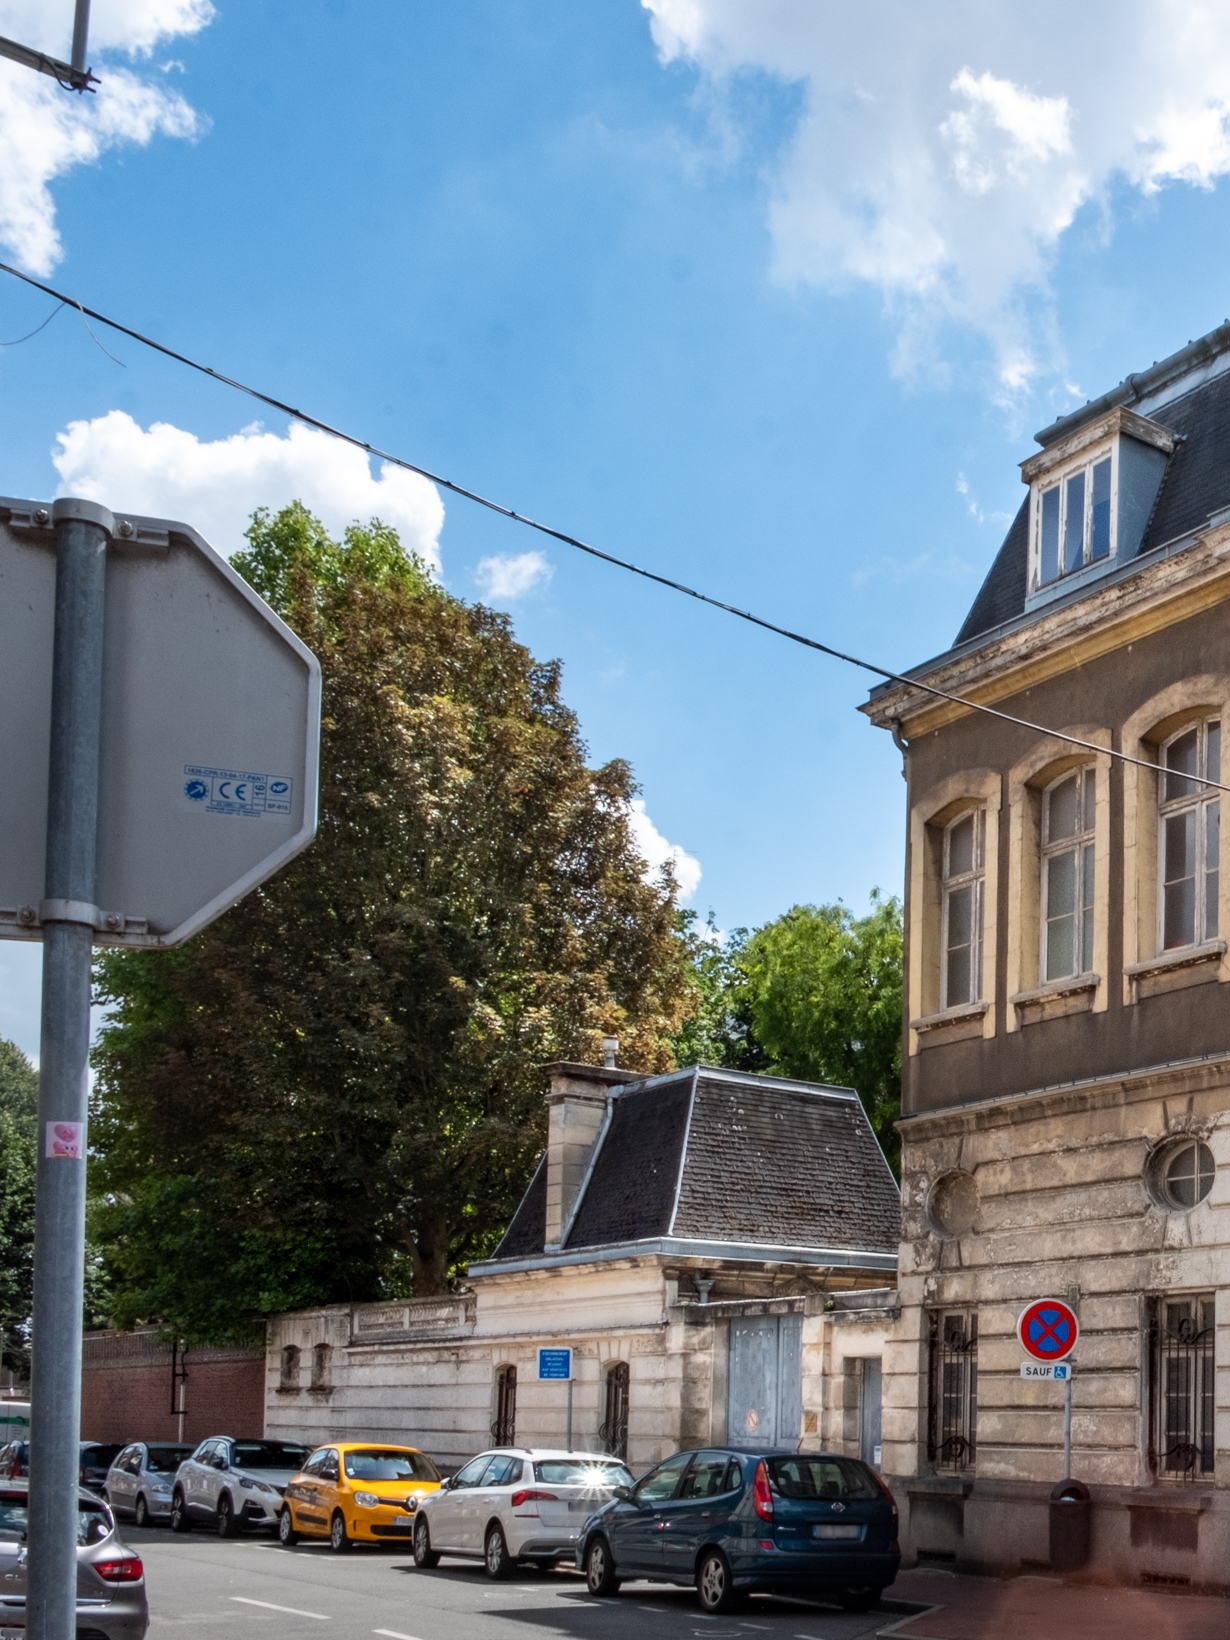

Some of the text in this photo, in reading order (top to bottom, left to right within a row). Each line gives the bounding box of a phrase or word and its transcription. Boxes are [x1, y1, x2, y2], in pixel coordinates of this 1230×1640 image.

[219, 782, 247, 801] CE
[254, 784, 265, 797] 16
[1026, 1366, 1052, 1376] SAUF
